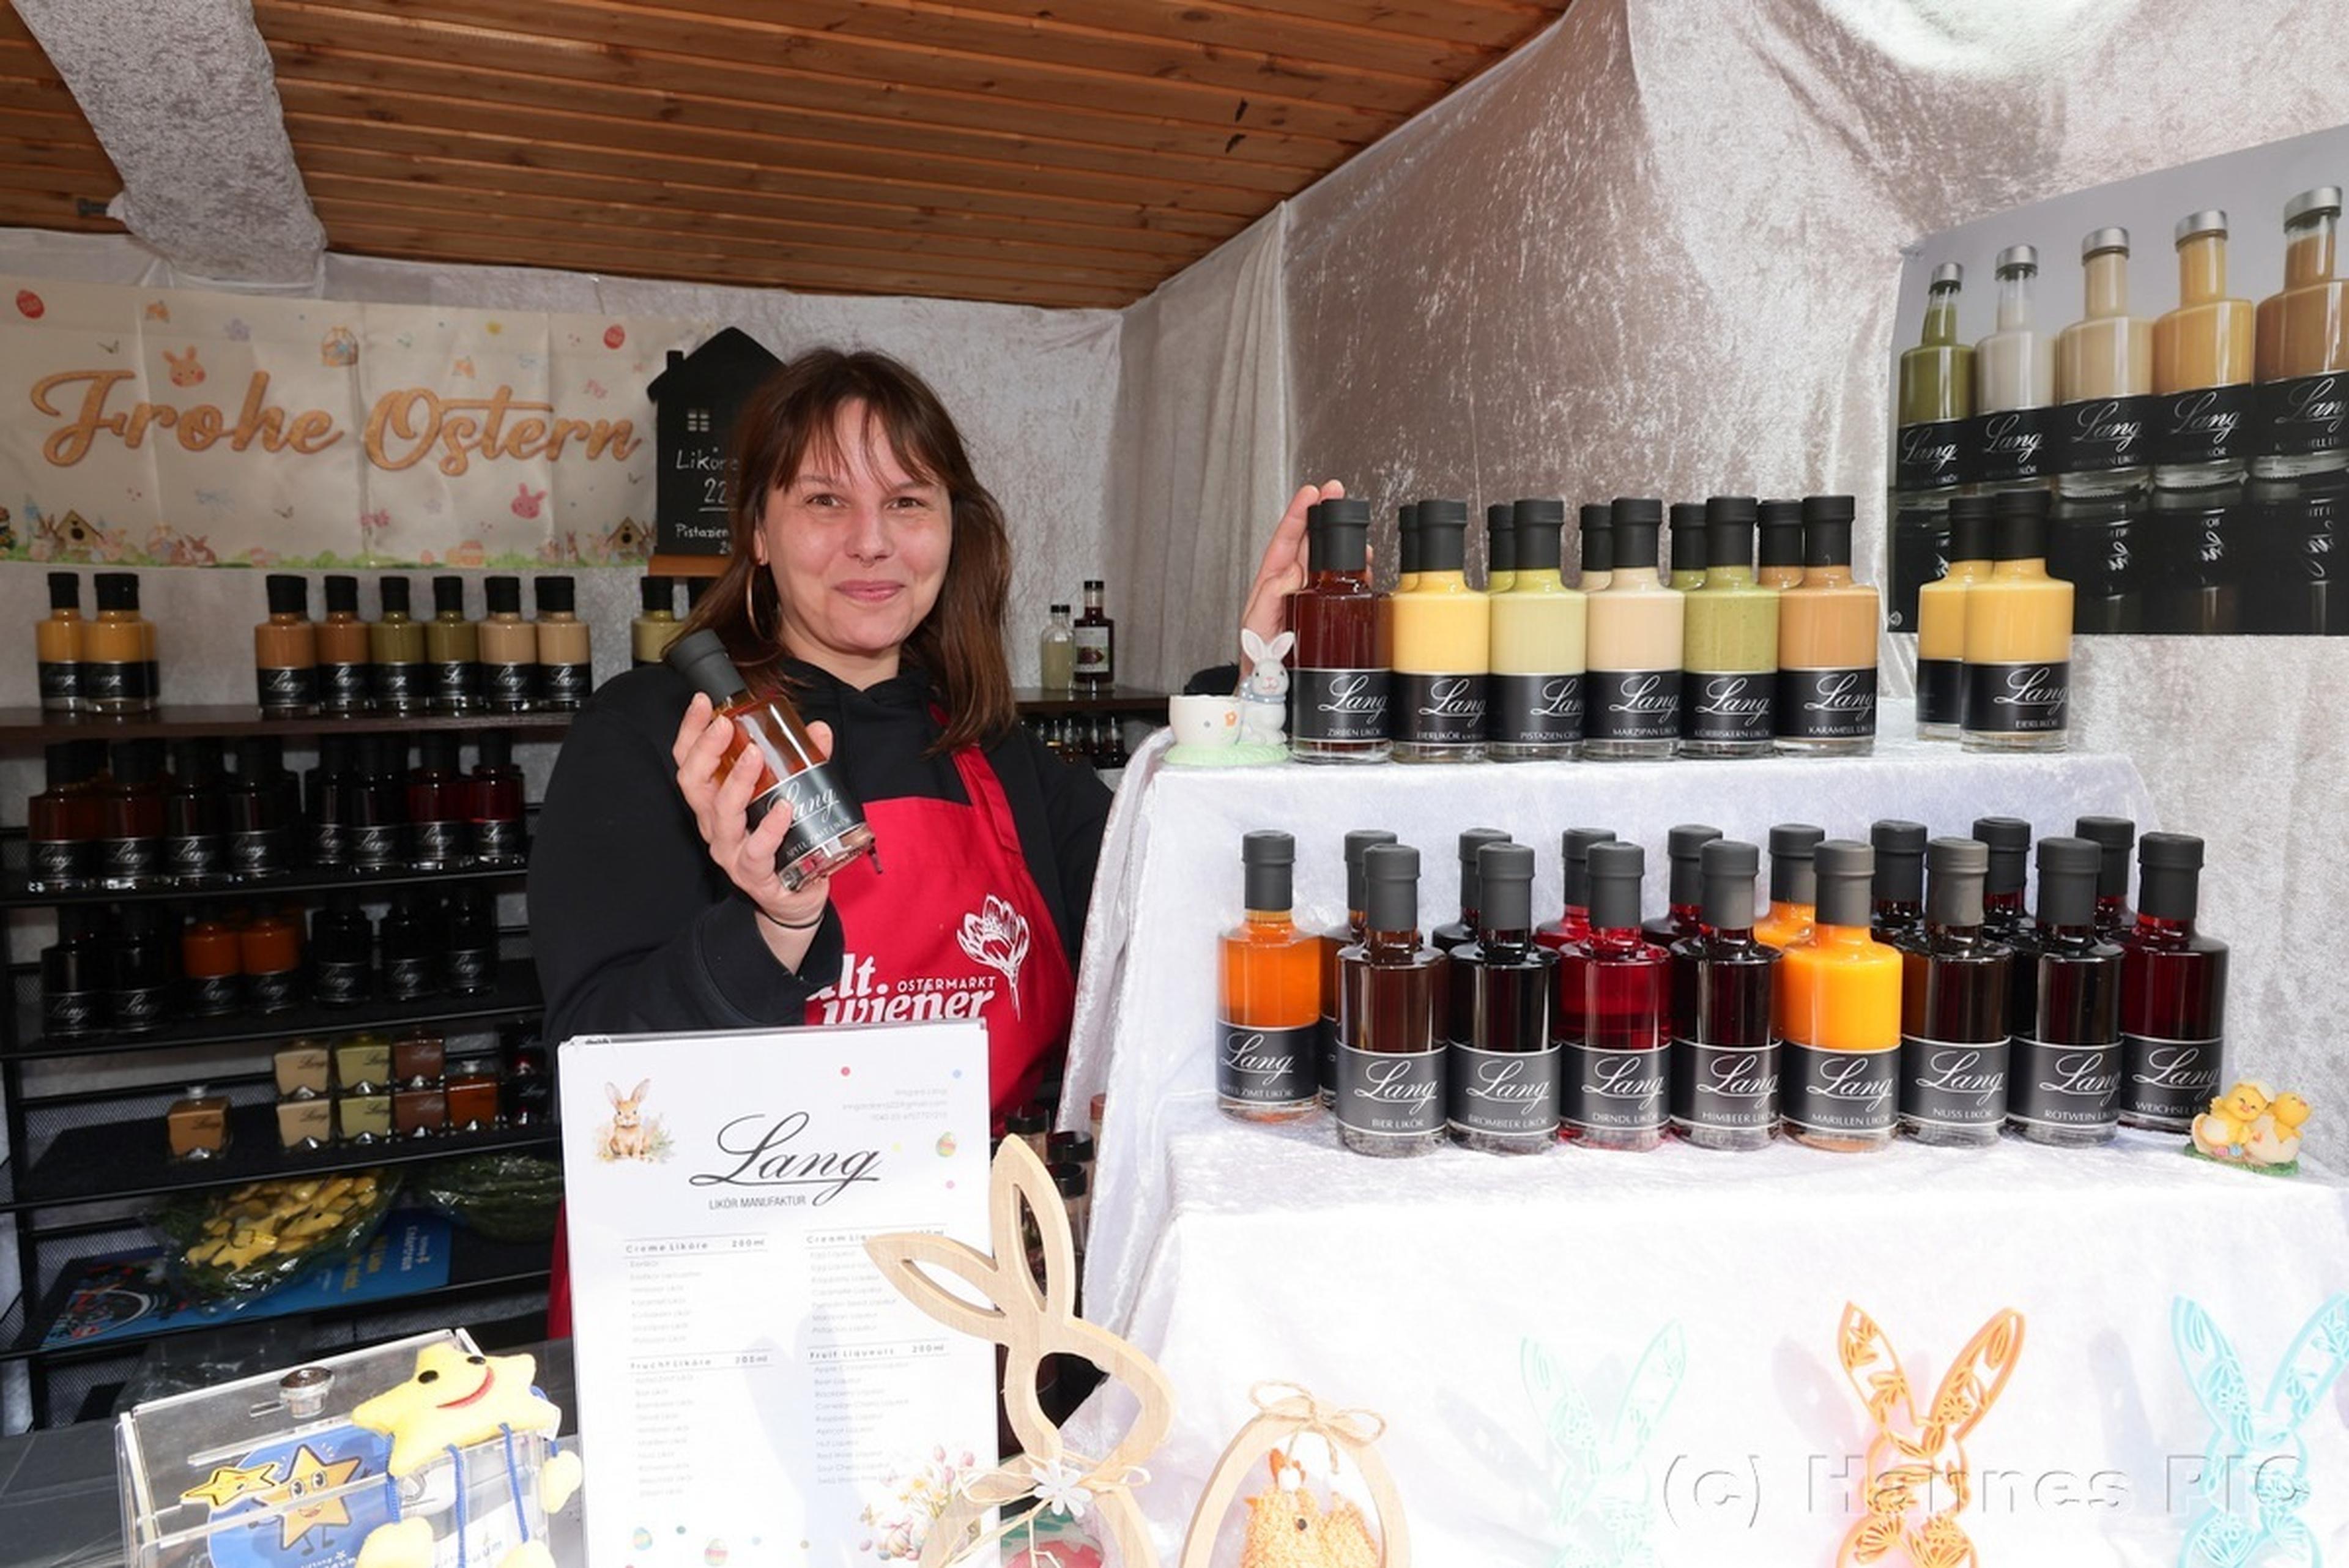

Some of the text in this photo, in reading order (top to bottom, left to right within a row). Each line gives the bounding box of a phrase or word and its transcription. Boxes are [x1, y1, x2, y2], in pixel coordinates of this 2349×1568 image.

[30, 369, 642, 477] Frohe Ostern
[1984, 414, 2042, 463] Lang
[2071, 401, 2142, 453] Lang
[2171, 392, 2240, 445] Lang
[1318, 675, 1387, 724] Lang
[1419, 678, 1486, 728] Lang
[1609, 675, 1679, 724] Lang
[1695, 677, 1771, 727] Lang
[1805, 673, 1876, 721] Lang
[1994, 667, 2068, 716] Lang
[1612, 727, 1658, 736] MARZIPAN
[822, 990, 996, 1025] wiener
[897, 976, 996, 994] OSTERMARKT
[1221, 1033, 1295, 1086] Lang
[1581, 1057, 1665, 1110] Lang
[1696, 1054, 1780, 1109] Lang
[1915, 1050, 2005, 1106] Lang
[2039, 1052, 2122, 1107] Lang
[2132, 1047, 2221, 1101] Lang
[1241, 1087, 1264, 1098] ZIMT
[1354, 1060, 1440, 1115] Lang
[1466, 1059, 1551, 1115] Lang
[1806, 1057, 1894, 1112] Lang
[2135, 1101, 2191, 1115] WEICHSEL
[1372, 1118, 1425, 1129] BIER LIKÖR
[1468, 1114, 1521, 1128] BROMBEER
[1592, 1112, 1631, 1124] DIRNDL
[1702, 1111, 1751, 1123] HIMBEER
[1812, 1112, 1865, 1126] MARILLEN
[1933, 1107, 1992, 1118] NUSS LIKÖR
[2044, 1109, 2097, 1121] ROTWEIN
[688, 1111, 882, 1206] Lang
[709, 1195, 806, 1211] LIKÖR MANUFAKTUR
